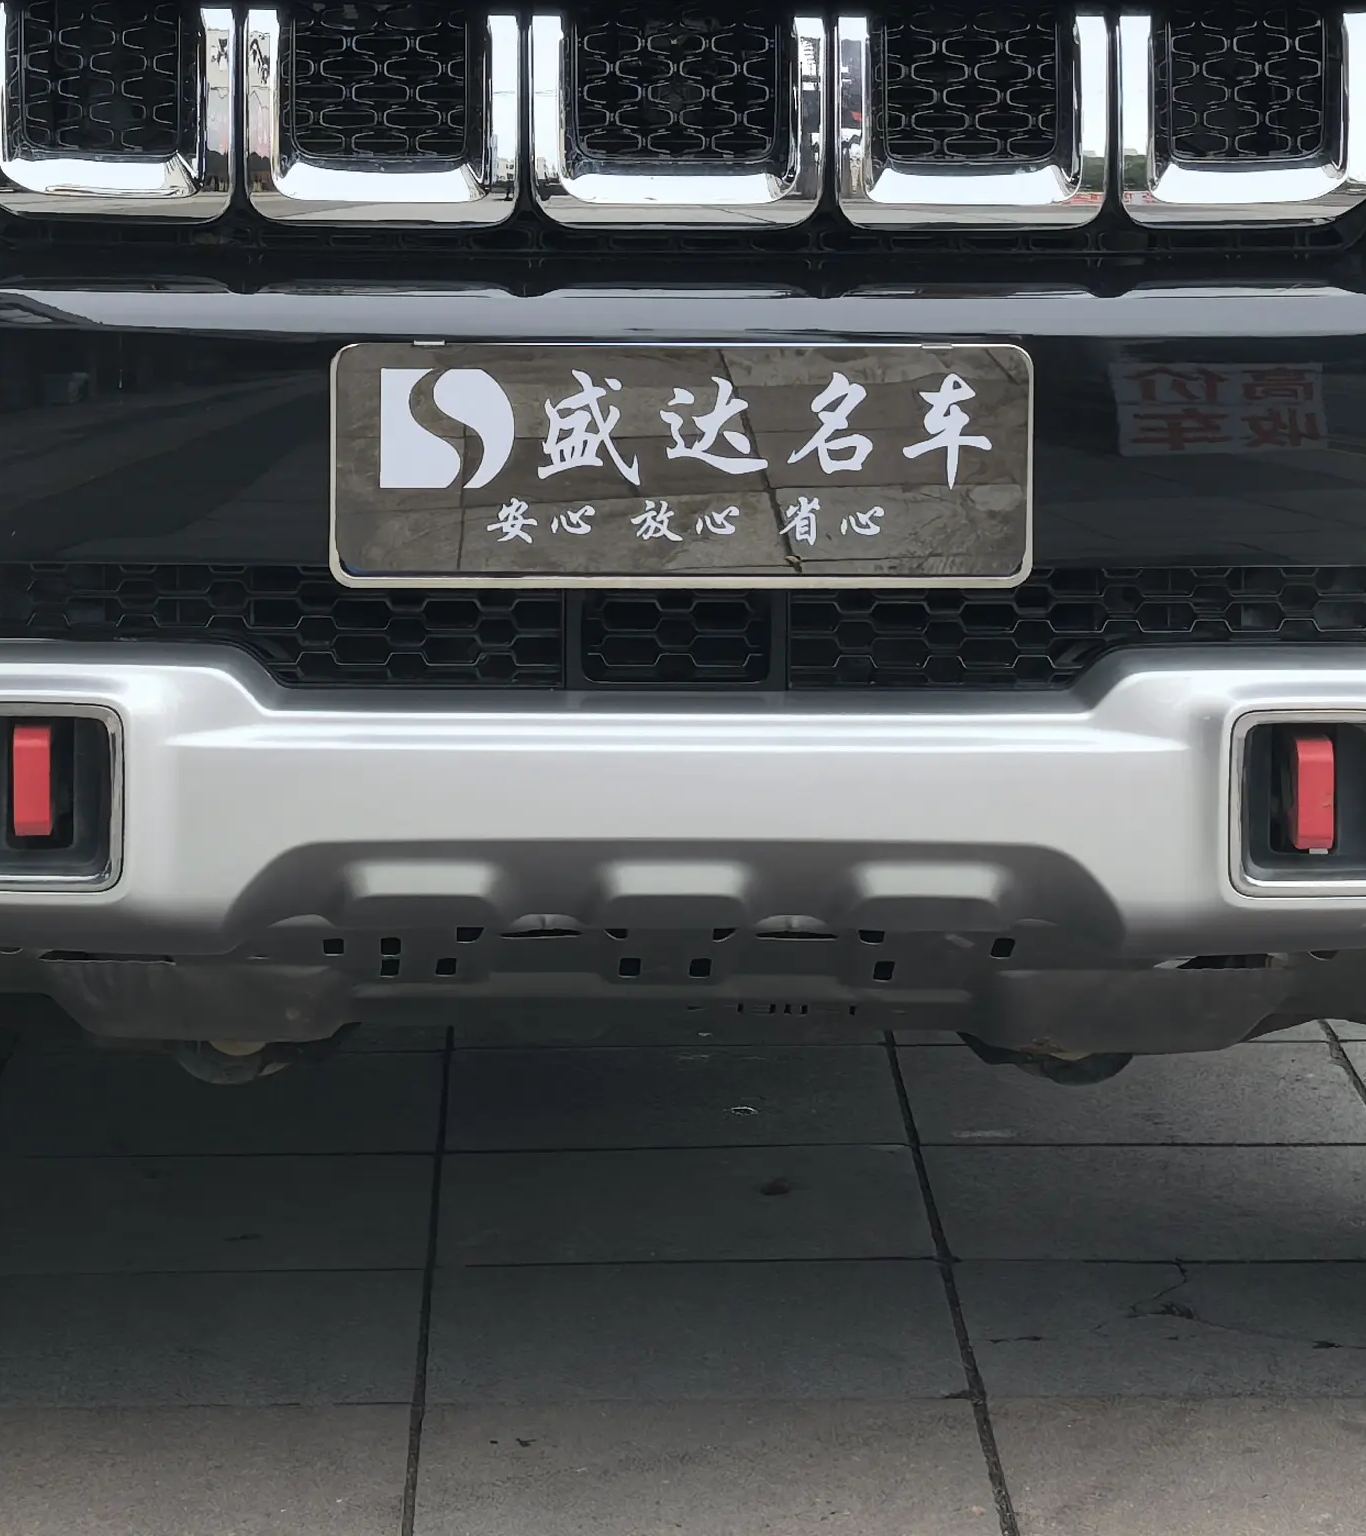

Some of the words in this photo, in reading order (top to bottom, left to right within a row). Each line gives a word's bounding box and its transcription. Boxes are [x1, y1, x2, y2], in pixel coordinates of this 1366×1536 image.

[537, 368, 992, 491] 盛达名车
[486, 496, 596, 545] 安心
[630, 497, 740, 543] 放心
[780, 496, 886, 545] 省心
